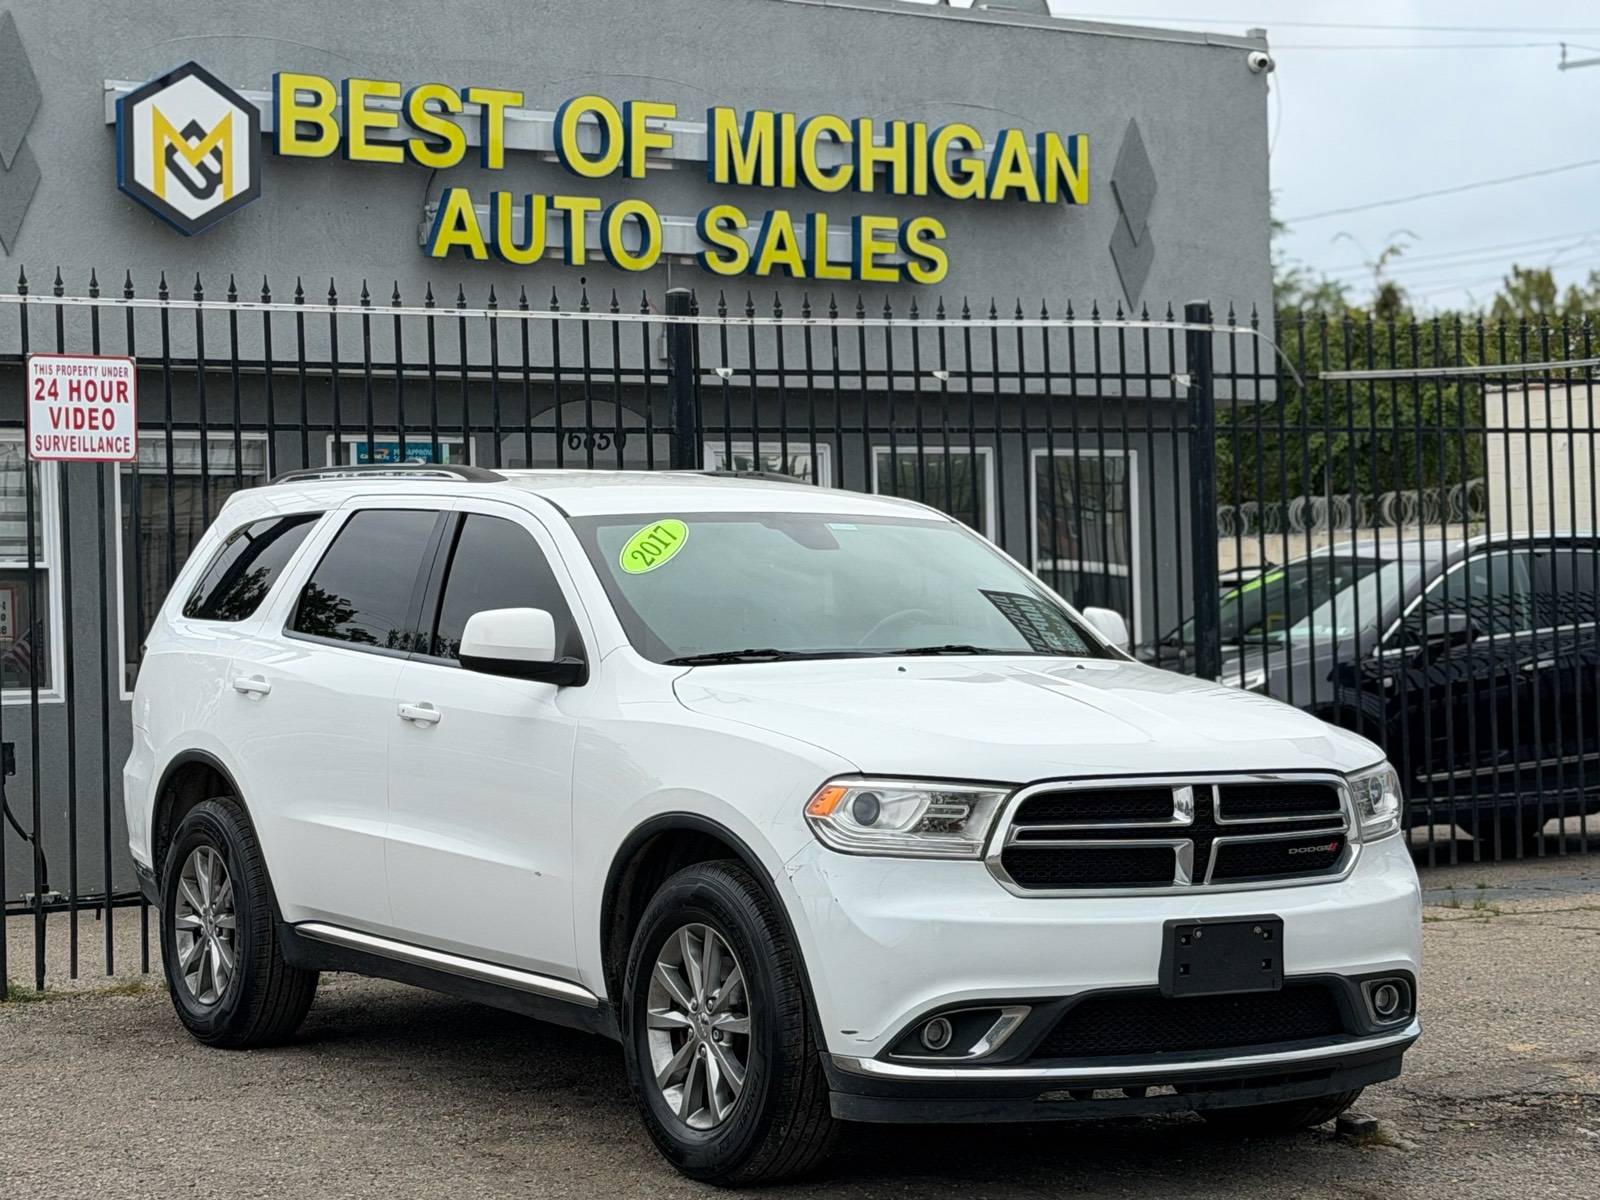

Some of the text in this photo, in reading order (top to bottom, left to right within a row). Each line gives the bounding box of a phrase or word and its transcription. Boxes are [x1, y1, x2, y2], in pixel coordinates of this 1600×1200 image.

[274, 72, 1089, 204] BEST OF MICHIGAN
[427, 187, 948, 284] AUTO SALES
[34, 364, 129, 377] THIS PROPERTY UNDER
[34, 378, 129, 403] 24 HOUR
[49, 407, 115, 431] VIDEO
[35, 435, 130, 453] SURVEILLANCE
[631, 525, 677, 567] 2017
